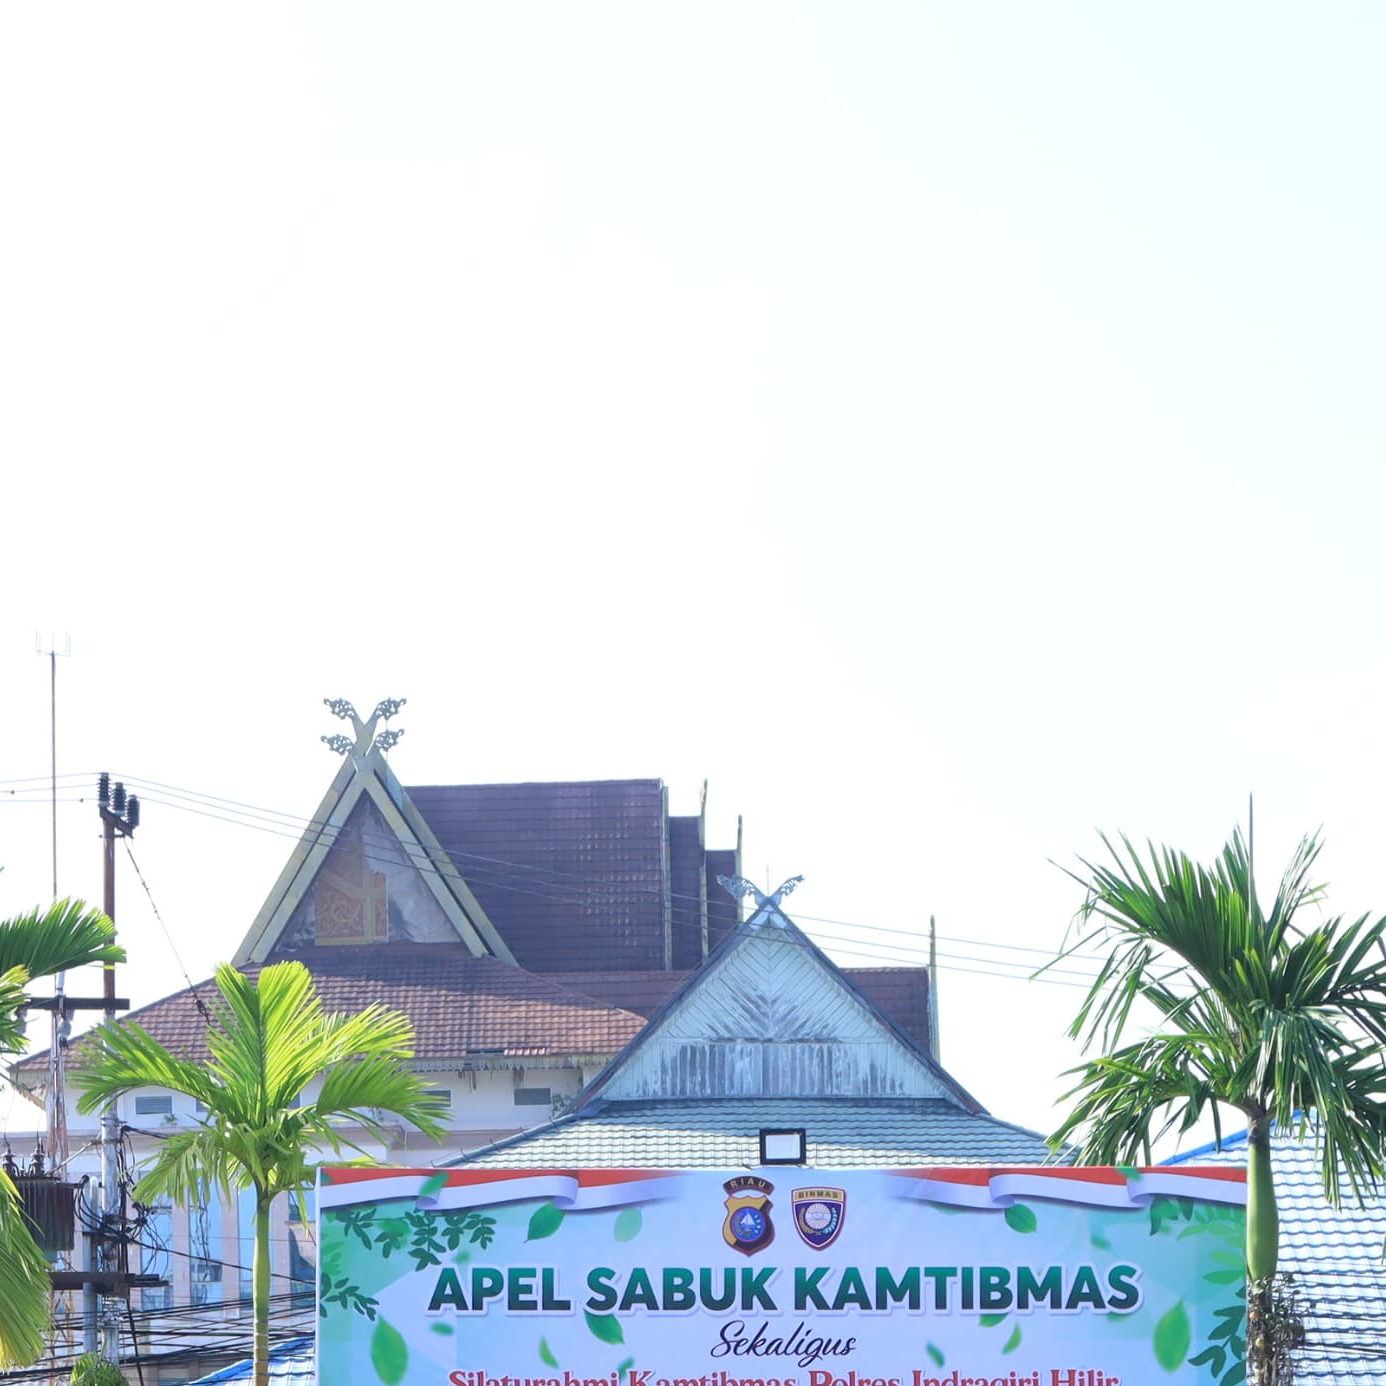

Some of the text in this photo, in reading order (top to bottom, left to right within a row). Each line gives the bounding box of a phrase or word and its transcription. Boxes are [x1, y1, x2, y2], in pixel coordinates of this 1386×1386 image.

[729, 1176, 767, 1189] RIAU
[798, 1189, 839, 1200] BINMAS
[428, 1264, 1140, 1312] APEL SABUK KAMTIBMAS
[710, 1320, 858, 1368] Sekaligus
